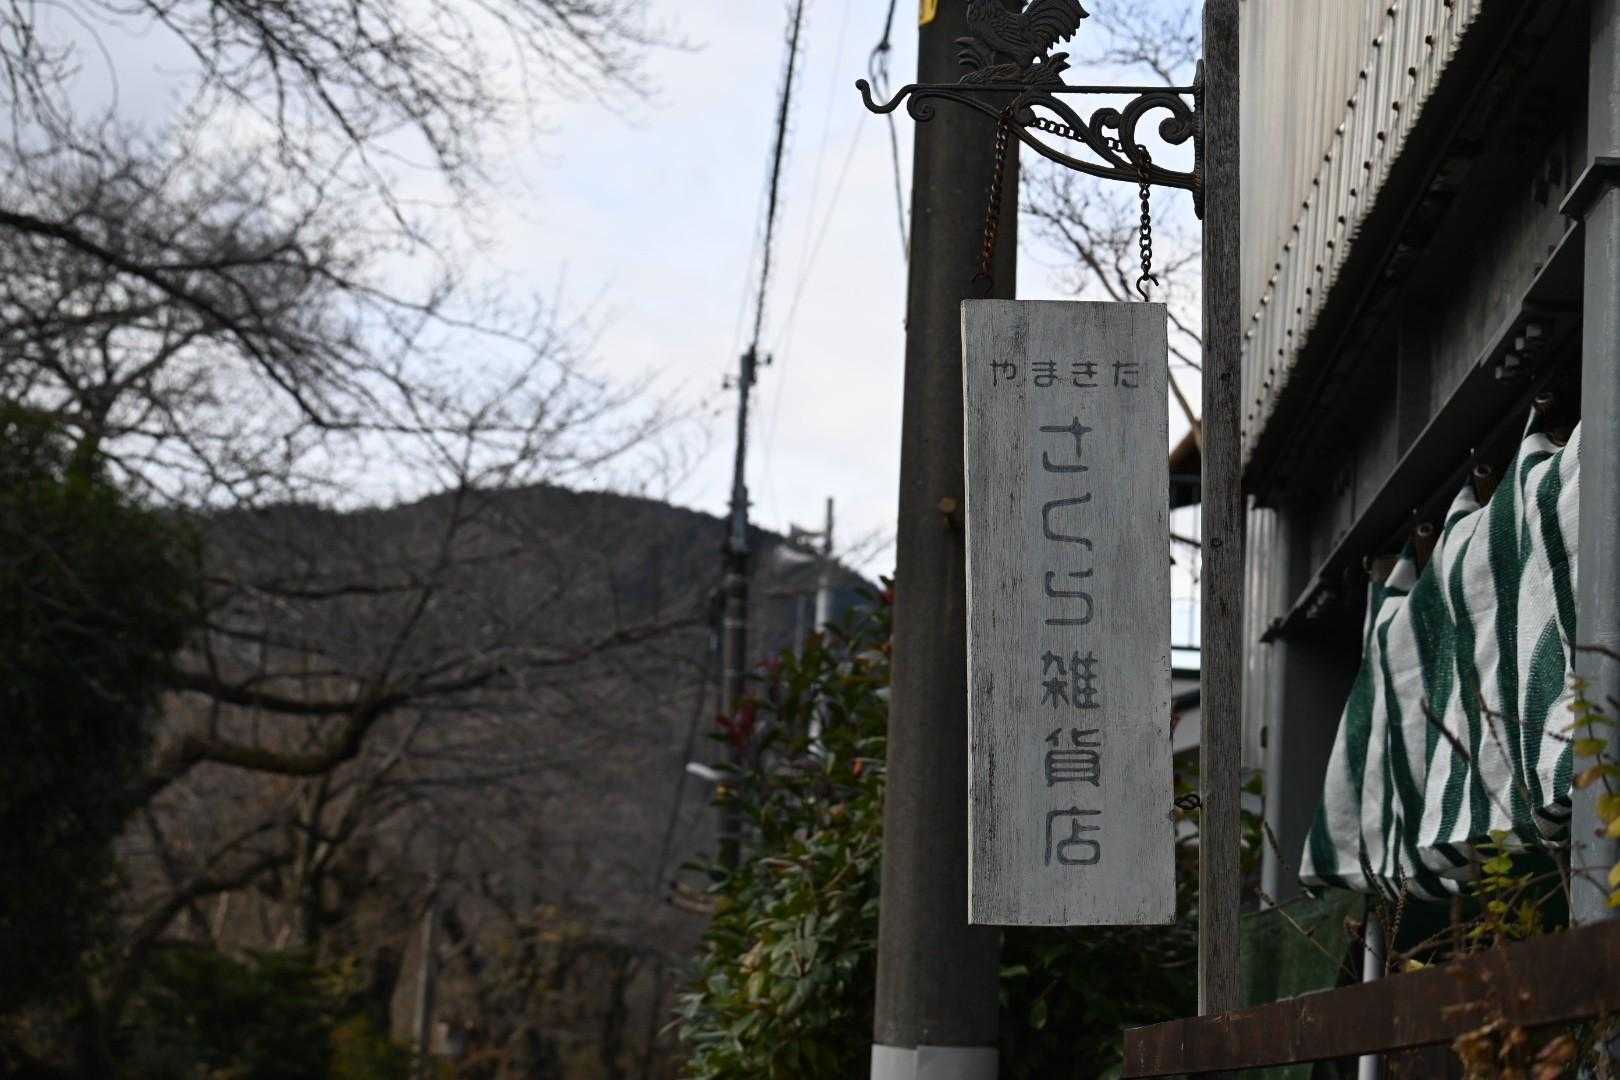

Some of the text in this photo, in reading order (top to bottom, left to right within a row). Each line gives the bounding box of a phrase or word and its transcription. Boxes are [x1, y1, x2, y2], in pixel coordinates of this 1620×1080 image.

[990, 359, 1139, 388] やまきた
[1039, 416, 1101, 866] さくら雑貨店
